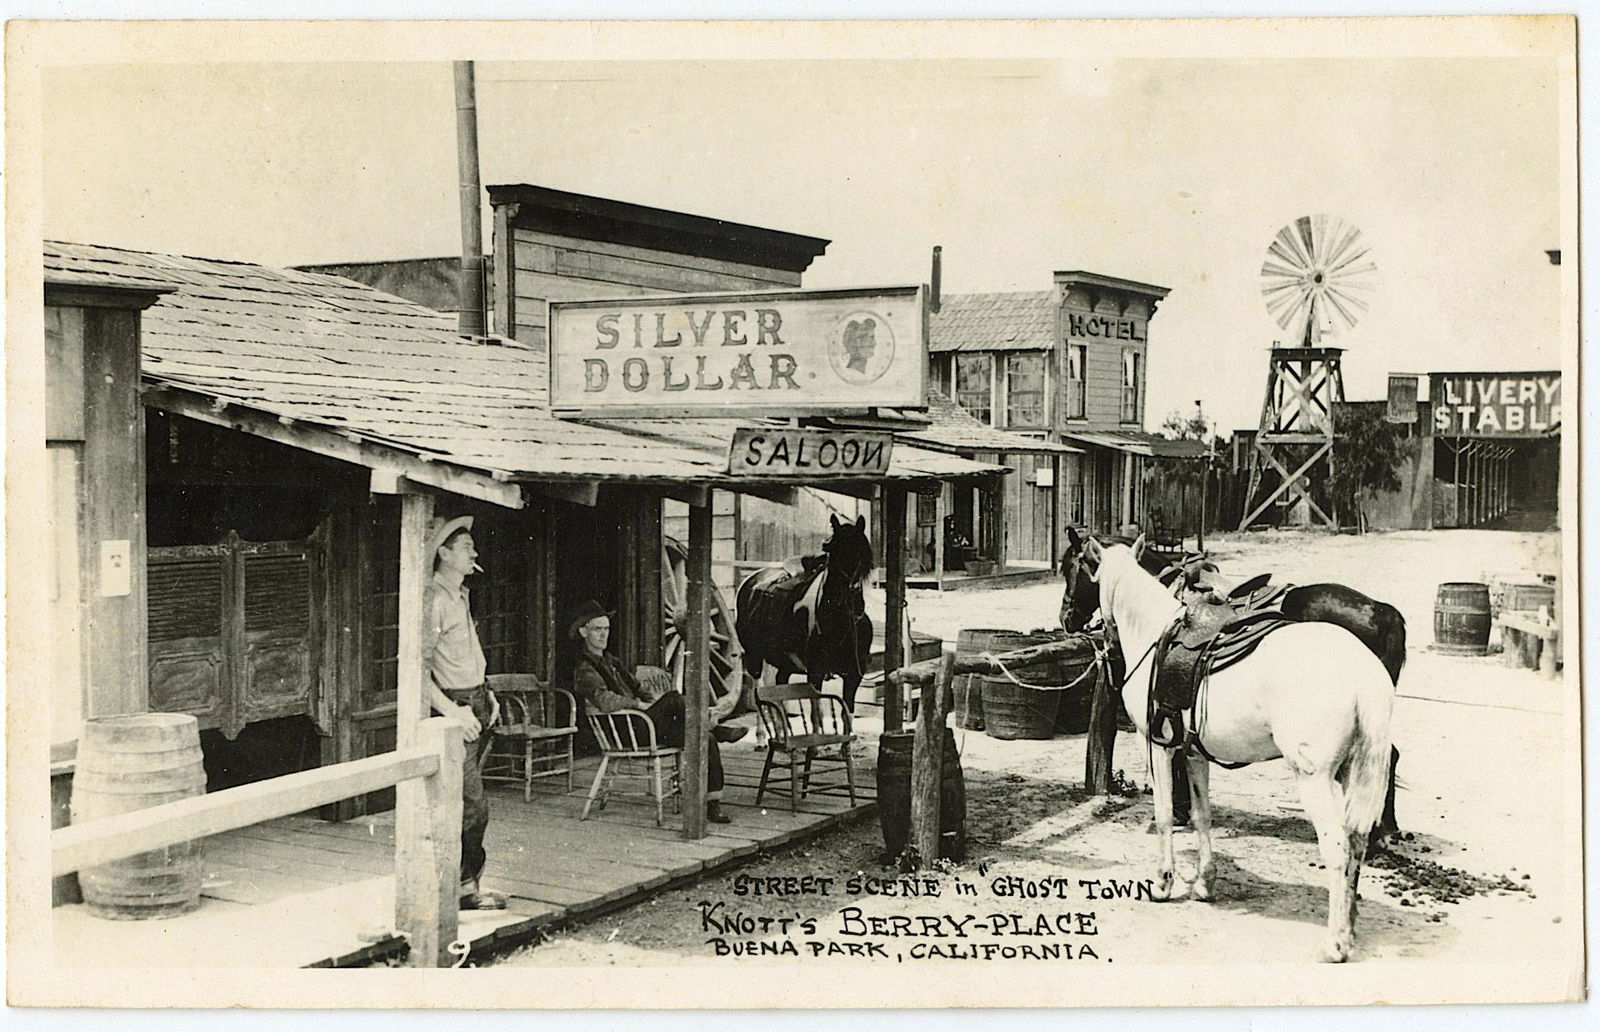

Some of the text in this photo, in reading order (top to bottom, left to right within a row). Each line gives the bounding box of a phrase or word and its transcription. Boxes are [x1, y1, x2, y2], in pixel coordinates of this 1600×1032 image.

[595, 308, 785, 350] SILVER
[1069, 313, 1144, 341] HOTEL
[583, 353, 801, 393] DOLLAR
[1446, 378, 1561, 405] LIVERY
[744, 436, 884, 470] SALOON
